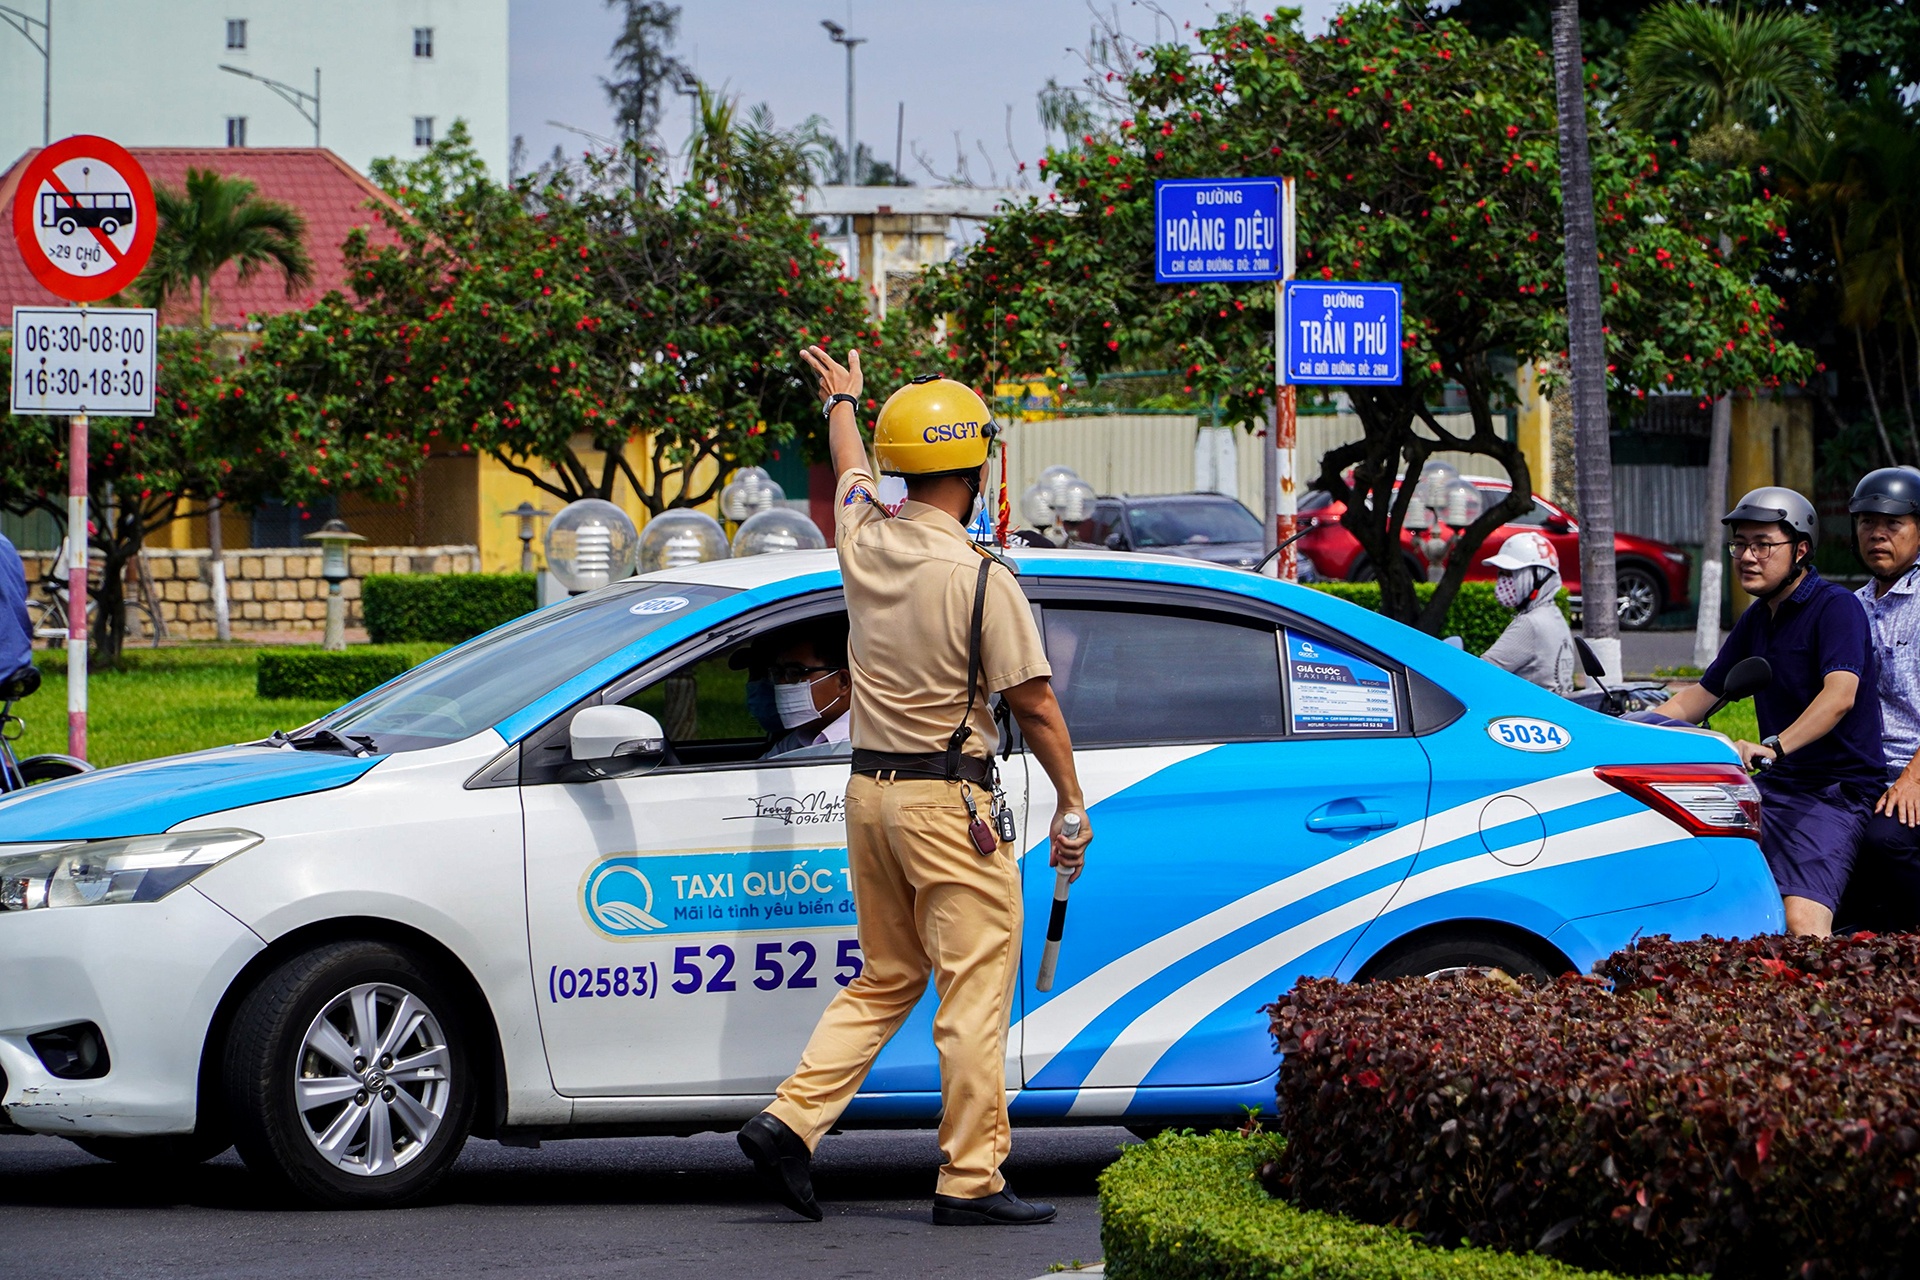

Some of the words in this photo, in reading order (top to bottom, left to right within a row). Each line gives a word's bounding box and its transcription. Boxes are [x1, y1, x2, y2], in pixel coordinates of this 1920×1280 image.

[1196, 187, 1243, 205] ĐƯỜNG
[1166, 210, 1226, 252] HOÀNG
[1234, 209, 1274, 257] DIỆU
[1322, 291, 1365, 309] ĐƯỜNG
[26, 325, 144, 354] 06:30-08:00
[1300, 309, 1346, 354] TRẦN
[1353, 315, 1387, 356] PHÚ
[25, 368, 144, 396] 16:30-18:30
[1296, 664, 1314, 673] GIÁ
[1315, 666, 1341, 676] CƯỚC
[1298, 672, 1320, 680] TAXI
[1324, 675, 1348, 683] FARE
[1498, 723, 1562, 745] 5034
[671, 873, 735, 900] TAXI
[742, 860, 833, 897] QUỐC
[673, 905, 703, 920] Mãi
[708, 904, 723, 919] là
[727, 903, 759, 918] tình
[764, 902, 793, 920] yêu
[798, 897, 833, 914] biển
[549, 961, 658, 1003] (02583)
[670, 944, 737, 995] 52
[752, 940, 818, 991] 52
